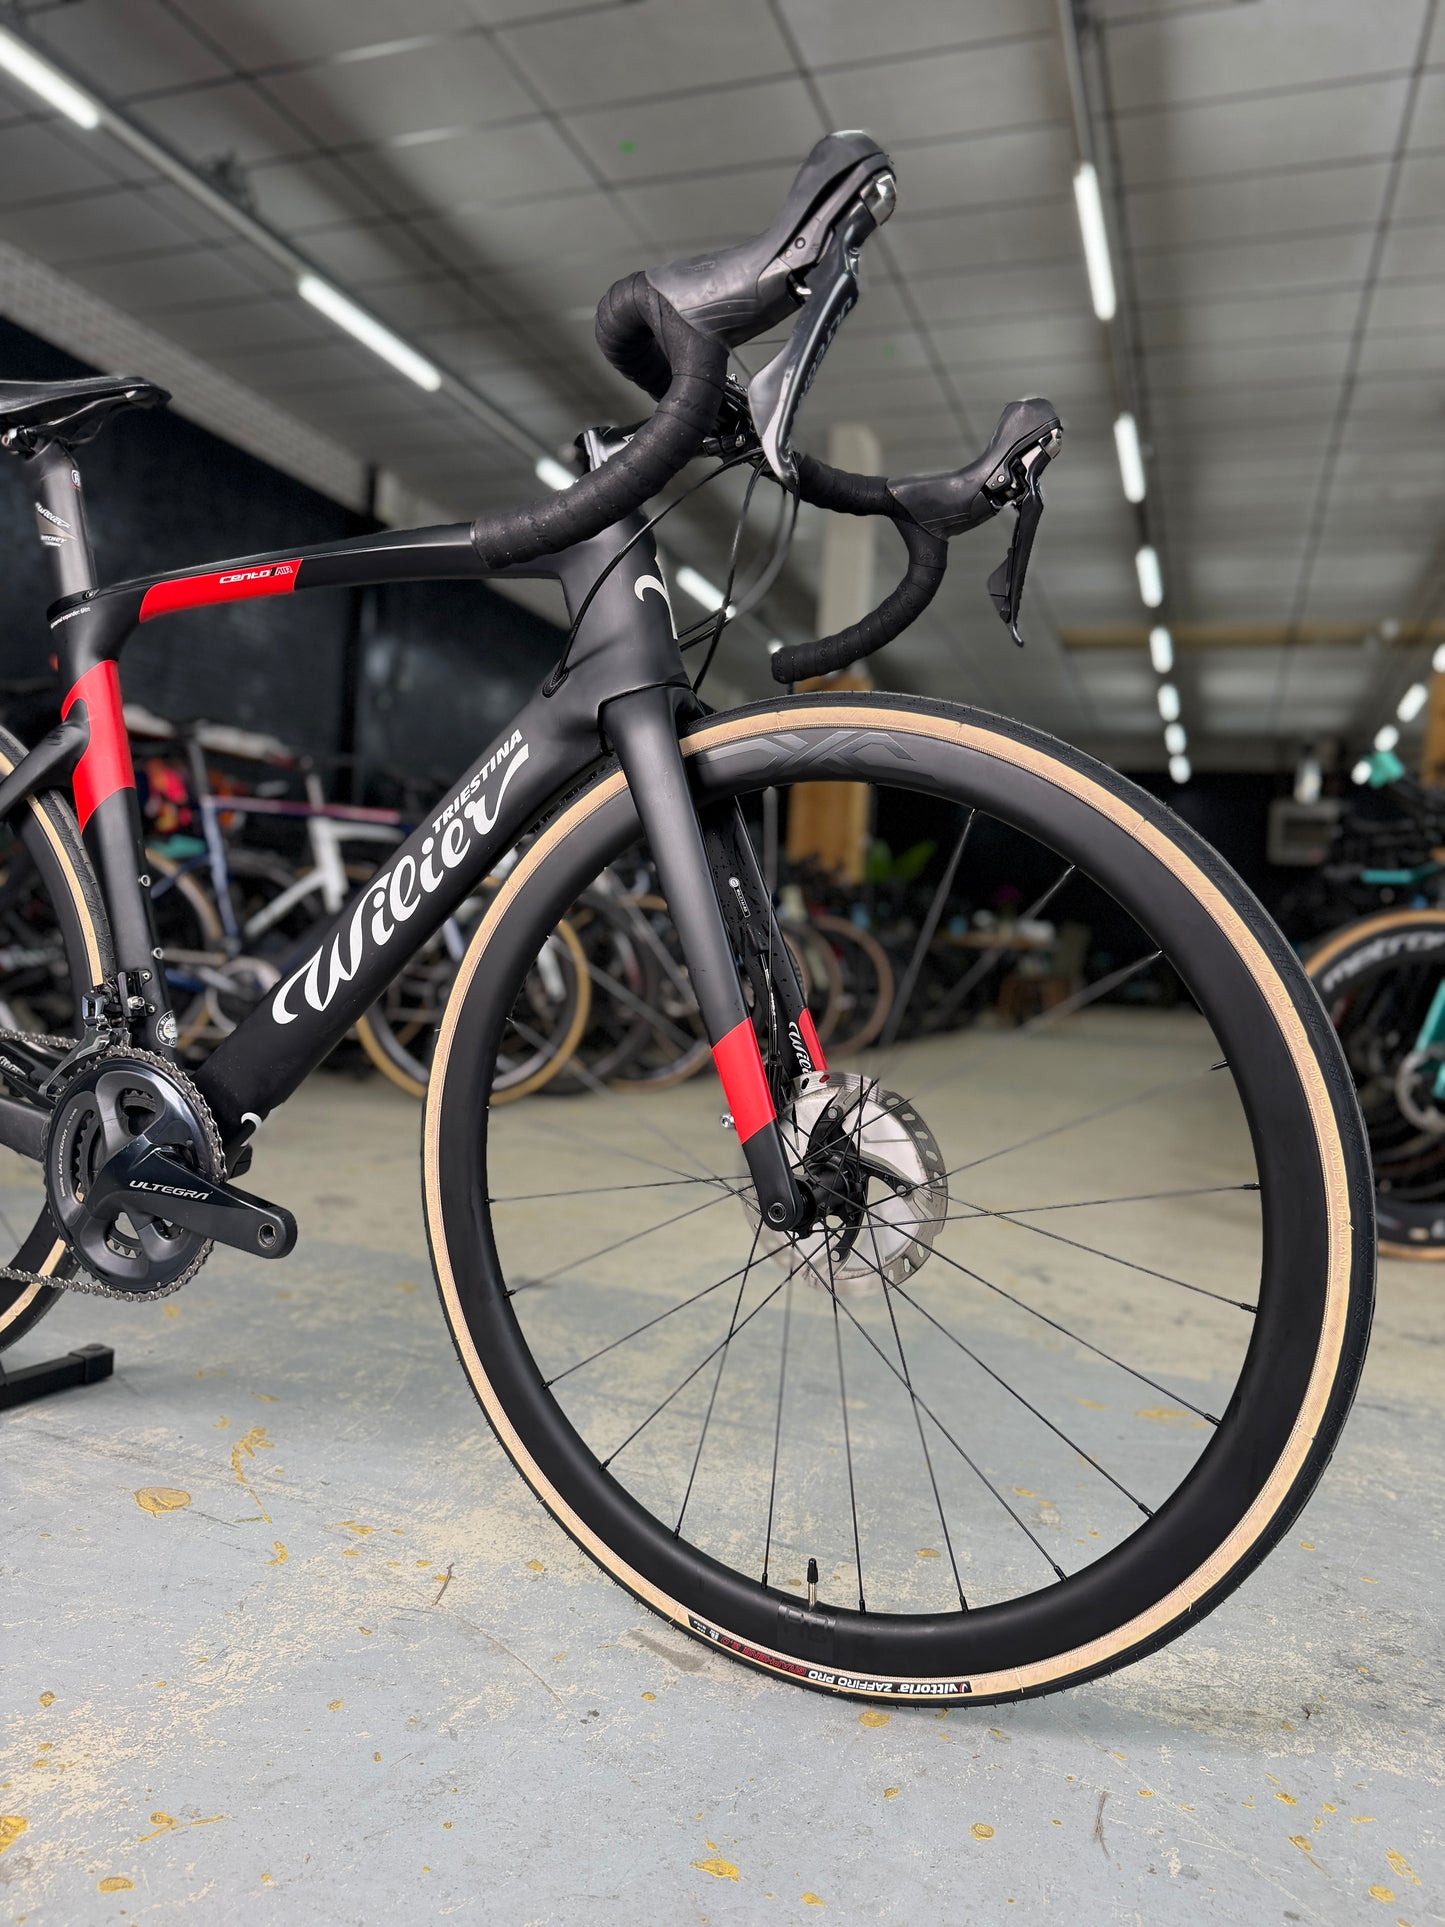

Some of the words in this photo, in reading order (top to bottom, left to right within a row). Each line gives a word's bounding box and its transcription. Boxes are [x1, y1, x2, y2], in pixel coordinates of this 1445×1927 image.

[432, 728, 523, 834] TRIESTINA
[271, 743, 530, 1025] Wilier
[1327, 1134, 1343, 1180] MADE
[129, 1180, 211, 1200] ULTEGRA
[1334, 1184, 1346, 1195] IN
[808, 1669, 836, 1684] PRO
[837, 1677, 893, 1692] ZAFFIRO
[898, 1682, 959, 1695] vittoria
